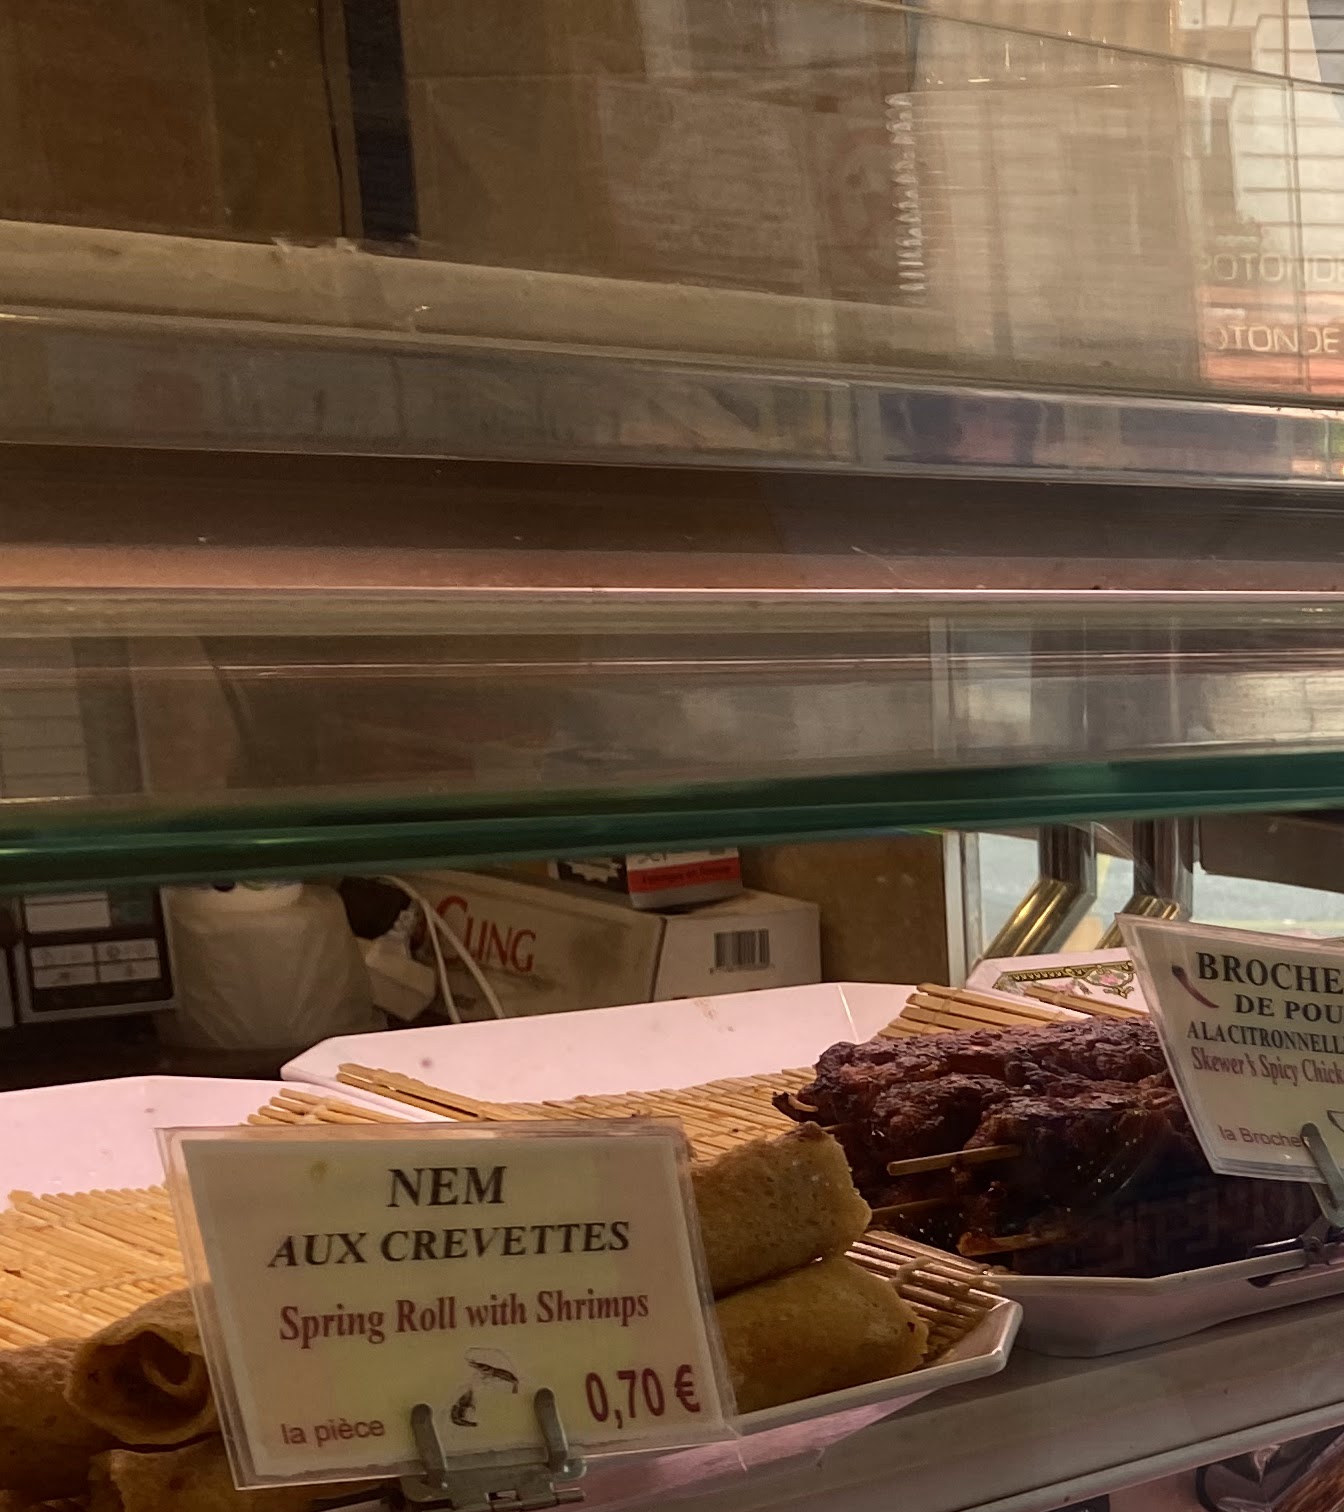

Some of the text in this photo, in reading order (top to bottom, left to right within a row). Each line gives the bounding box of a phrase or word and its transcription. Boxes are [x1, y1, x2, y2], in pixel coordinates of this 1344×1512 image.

[1234, 994, 1275, 1017] DE
[1258, 1054, 1299, 1087] Spicy
[1218, 1124, 1302, 1148] la Broche
[387, 1166, 507, 1208] NEM
[267, 1221, 630, 1268] AUX CREVETTES
[280, 1288, 649, 1349] Spring Roll with Shrimps
[584, 1363, 701, 1431] 0,70 €
[282, 1416, 385, 1446] la pièce
